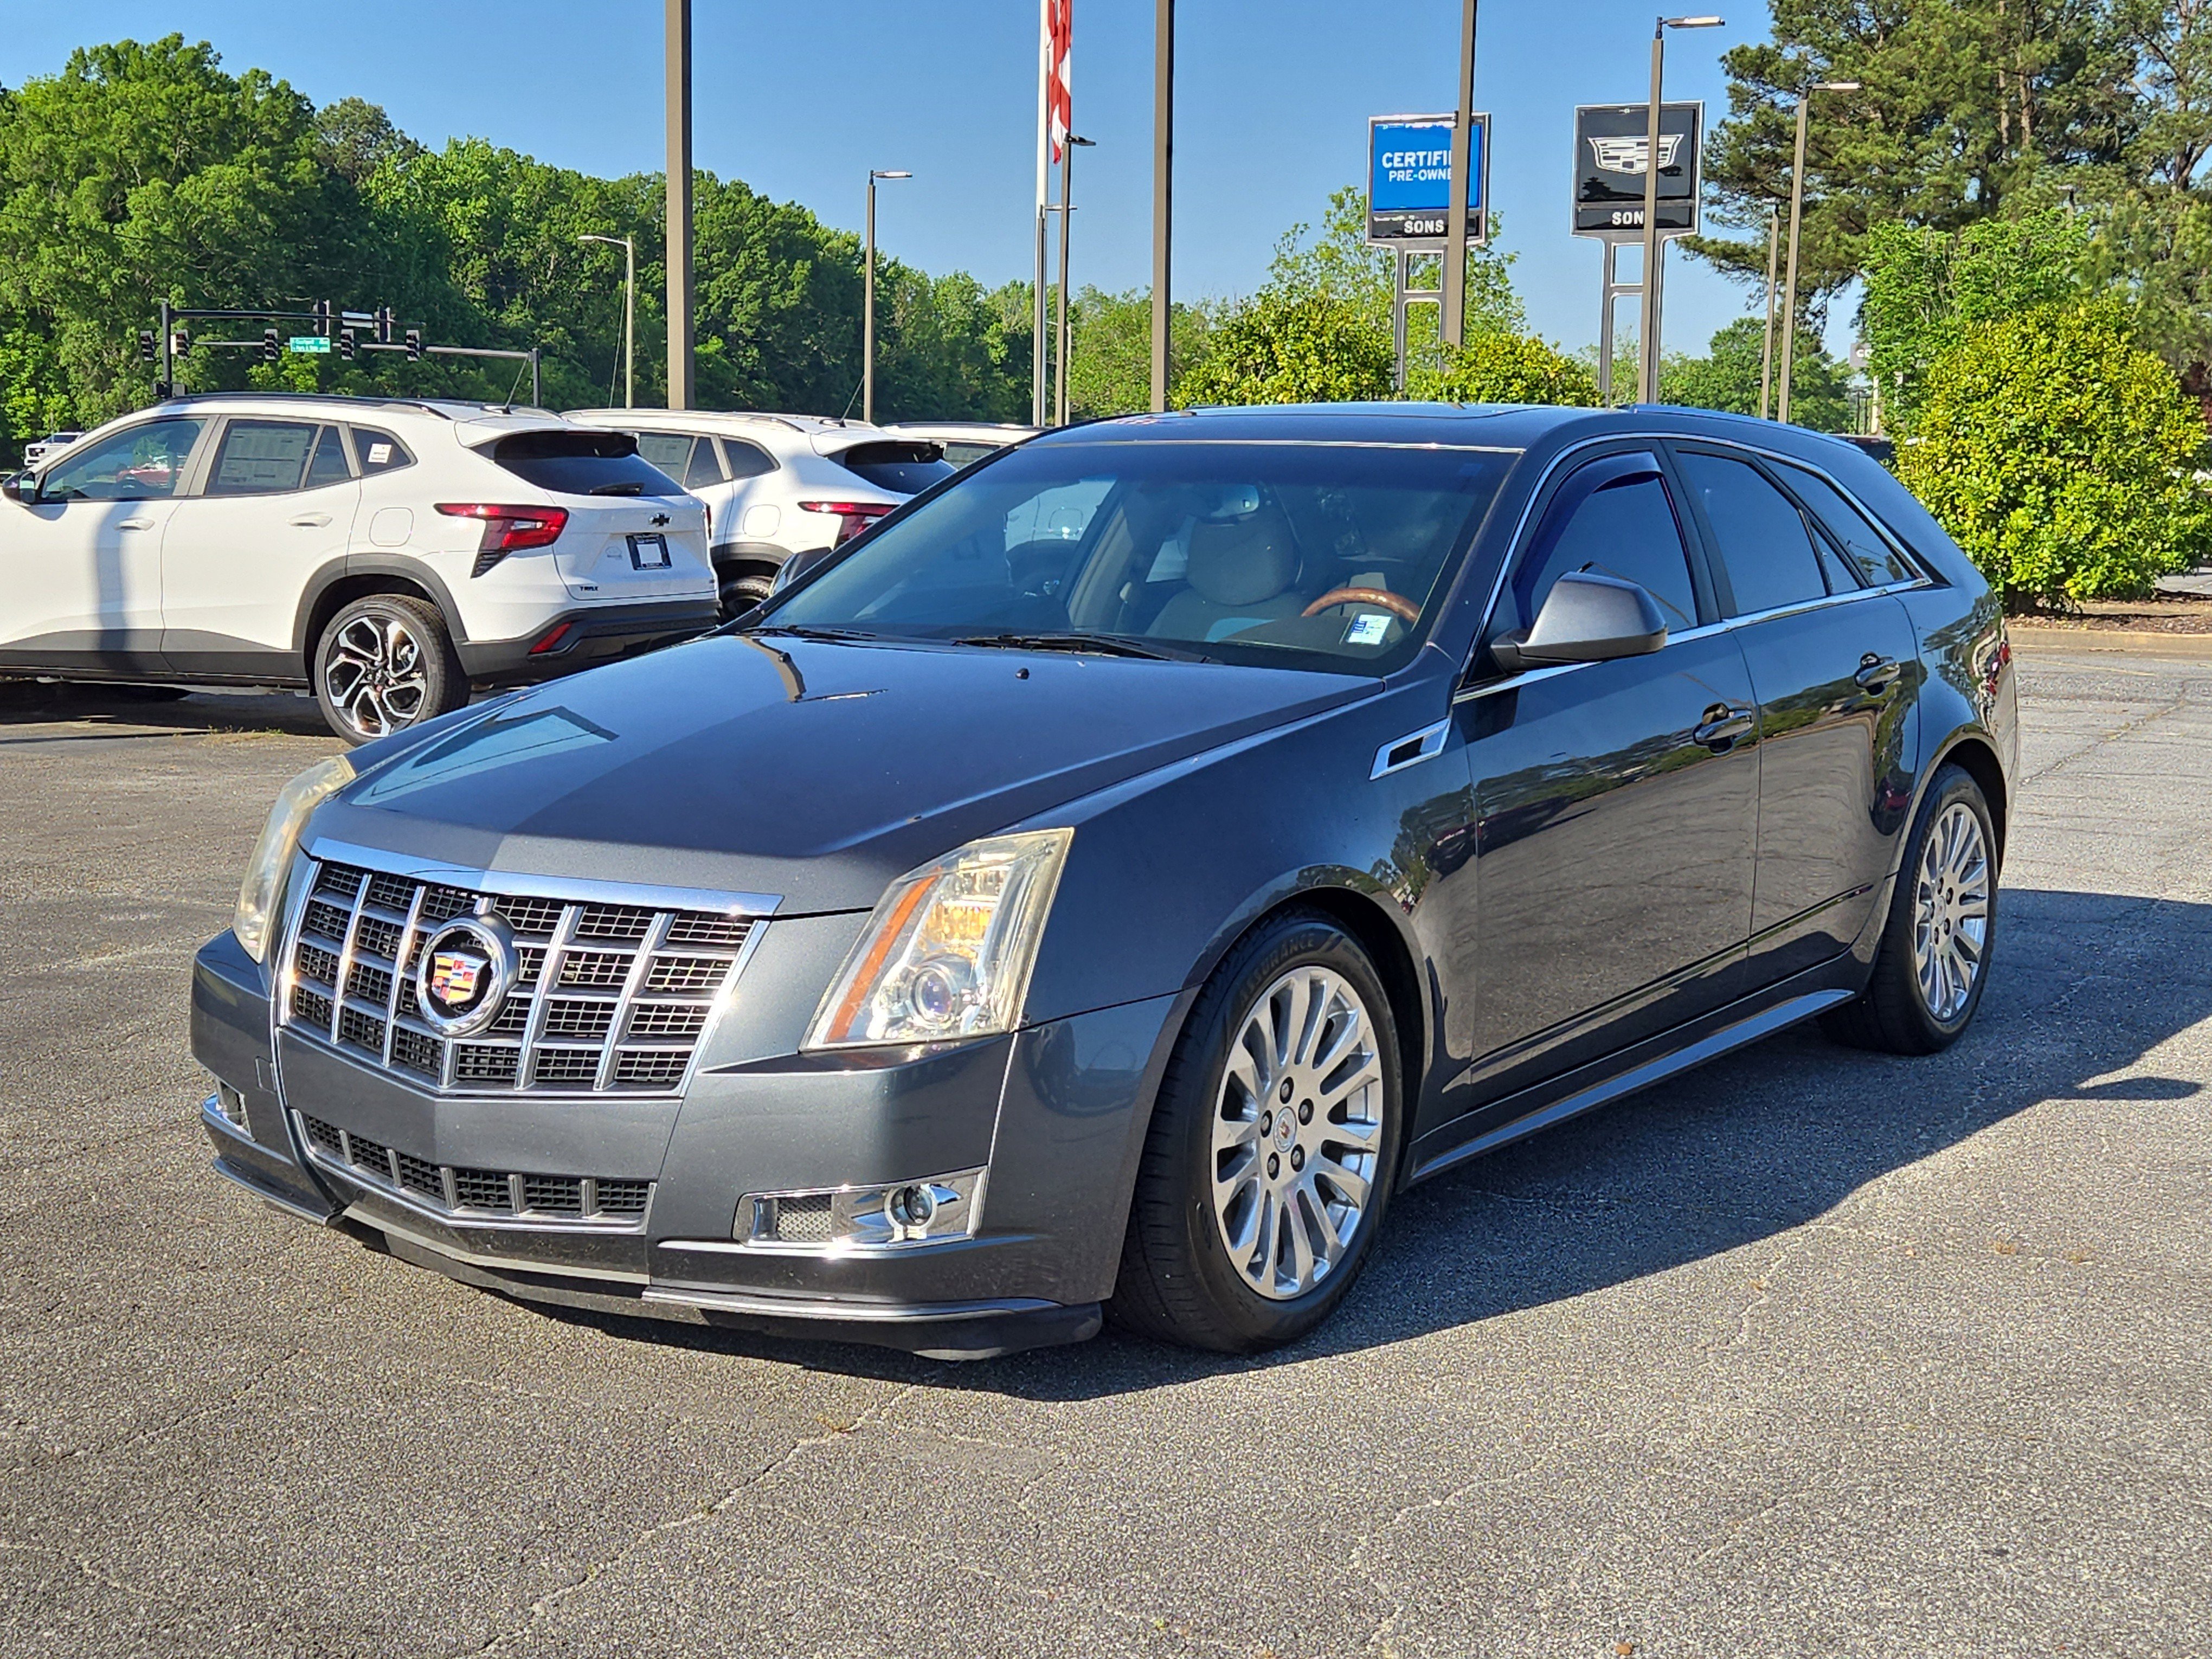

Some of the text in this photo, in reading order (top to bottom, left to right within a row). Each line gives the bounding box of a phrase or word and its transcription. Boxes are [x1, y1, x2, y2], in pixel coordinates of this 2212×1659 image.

[1382, 150, 1451, 168] CERTIFI
[1389, 168, 1451, 182] PRE-OWNE
[1612, 211, 1644, 226] SON
[1404, 220, 1444, 233] SONS
[1239, 933, 1314, 1006] ASSURANCE
